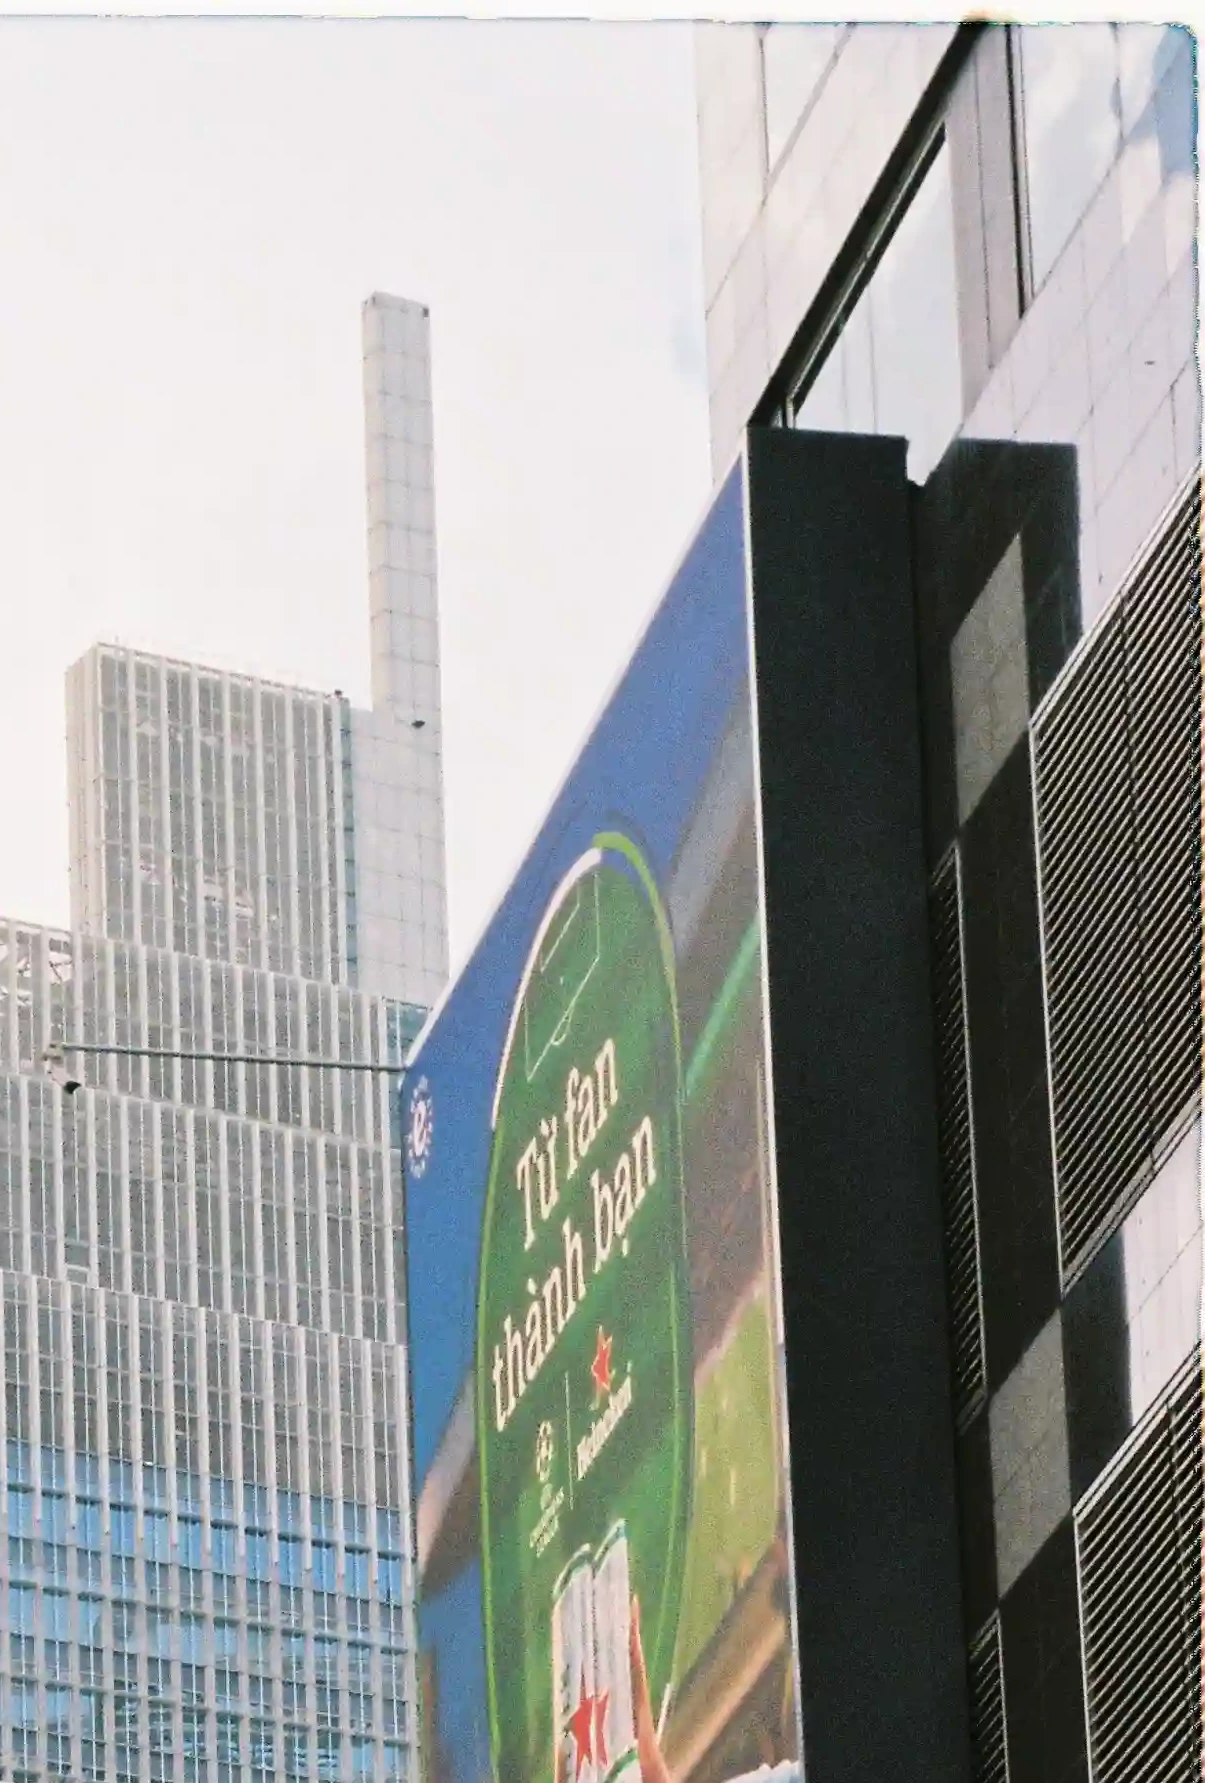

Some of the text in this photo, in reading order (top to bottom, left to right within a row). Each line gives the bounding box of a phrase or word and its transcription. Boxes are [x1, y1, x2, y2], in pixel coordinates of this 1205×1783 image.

[492, 1217, 586, 1431] thành
[590, 1115, 657, 1274] bạn
[516, 1038, 619, 1250] Từ fan
